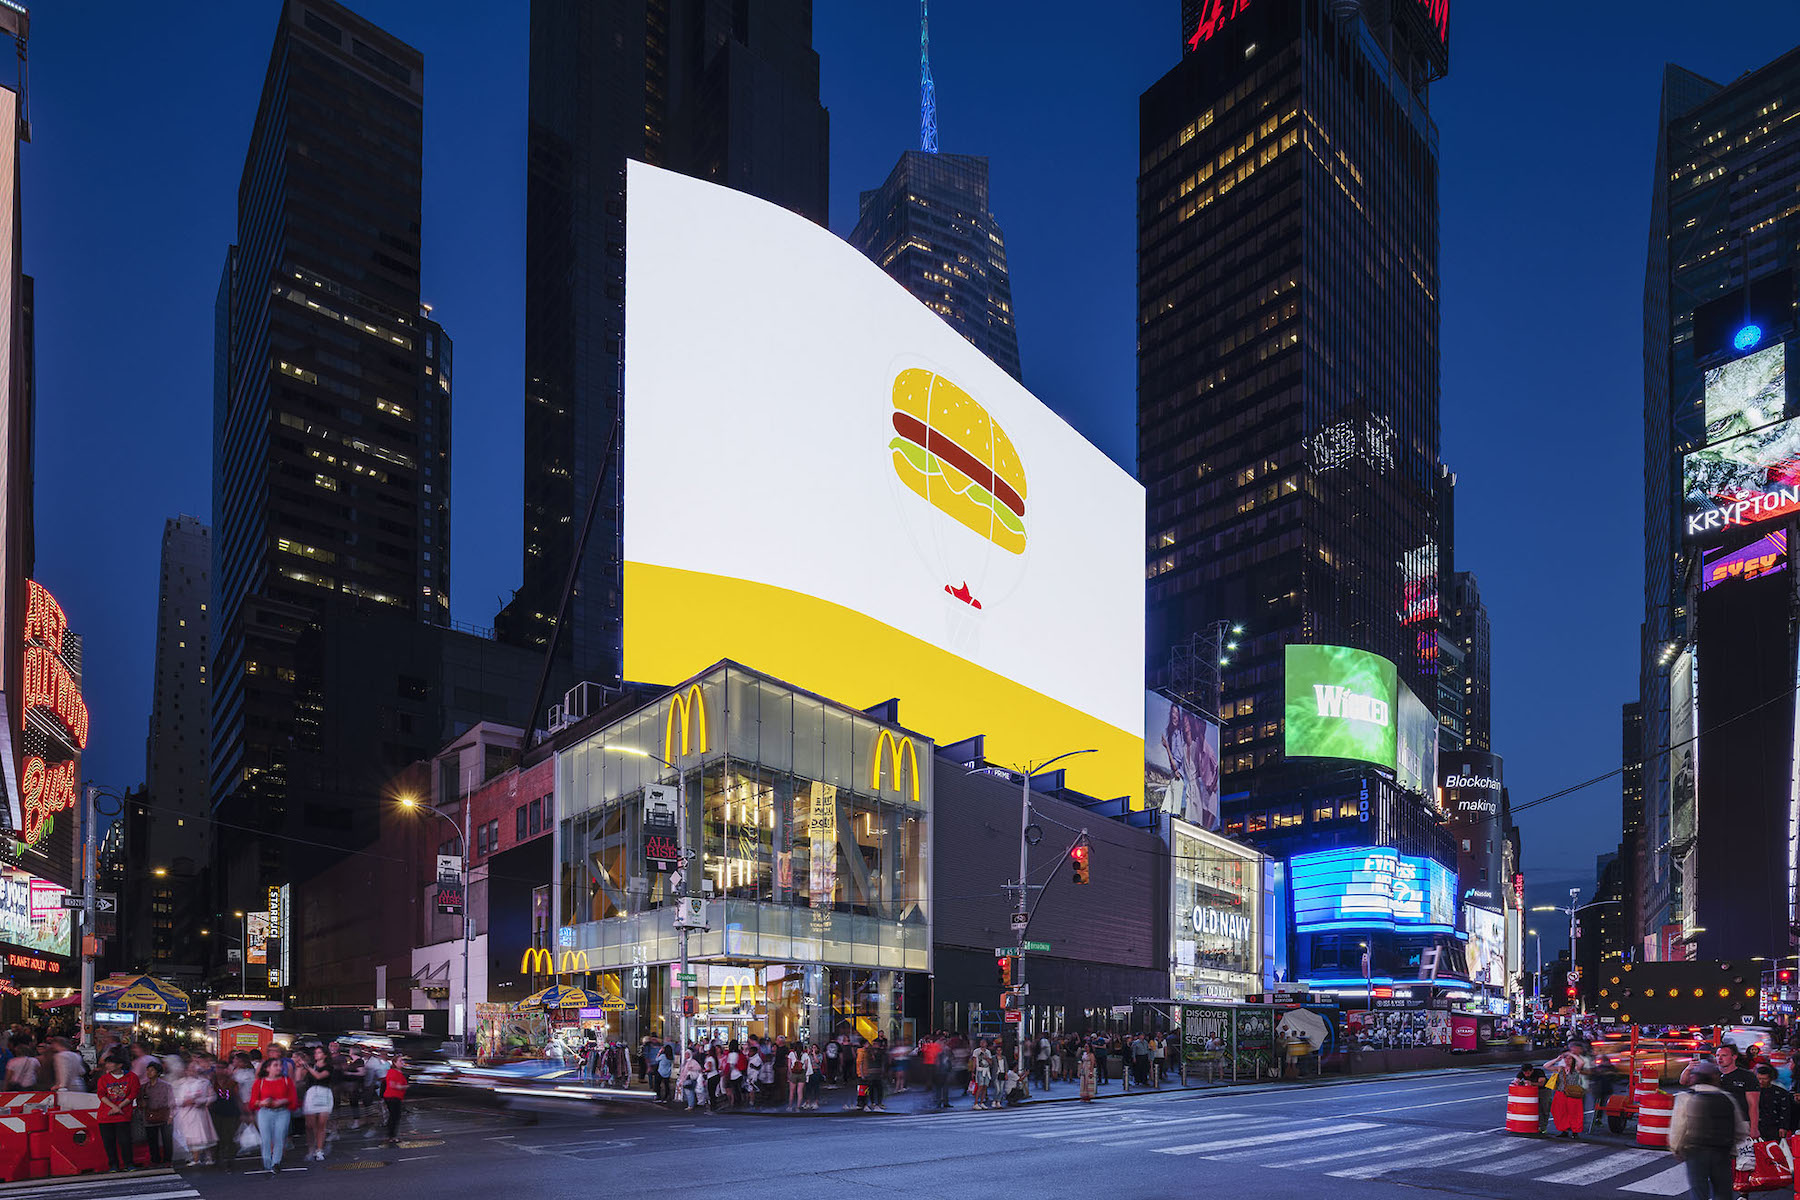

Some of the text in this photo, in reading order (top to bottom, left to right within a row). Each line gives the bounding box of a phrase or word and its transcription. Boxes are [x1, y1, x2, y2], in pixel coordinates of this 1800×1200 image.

[1688, 485, 1800, 535] KRYPTON
[1445, 774, 1501, 791] Blockchain
[1359, 778, 1369, 823] 1500
[1458, 799, 1496, 815] making
[647, 836, 675, 848] ALL
[646, 845, 677, 859] RISE
[438, 896, 462, 905] RISE
[440, 889, 460, 898] ALL
[1193, 905, 1251, 941] OLD NAVY
[9, 953, 60, 973] PLANET HOLLYOOD
[120, 1001, 164, 1010] SABRETT
[1185, 1009, 1228, 1019] DISCOVER
[1185, 1016, 1228, 1038] BROADWAY'S
